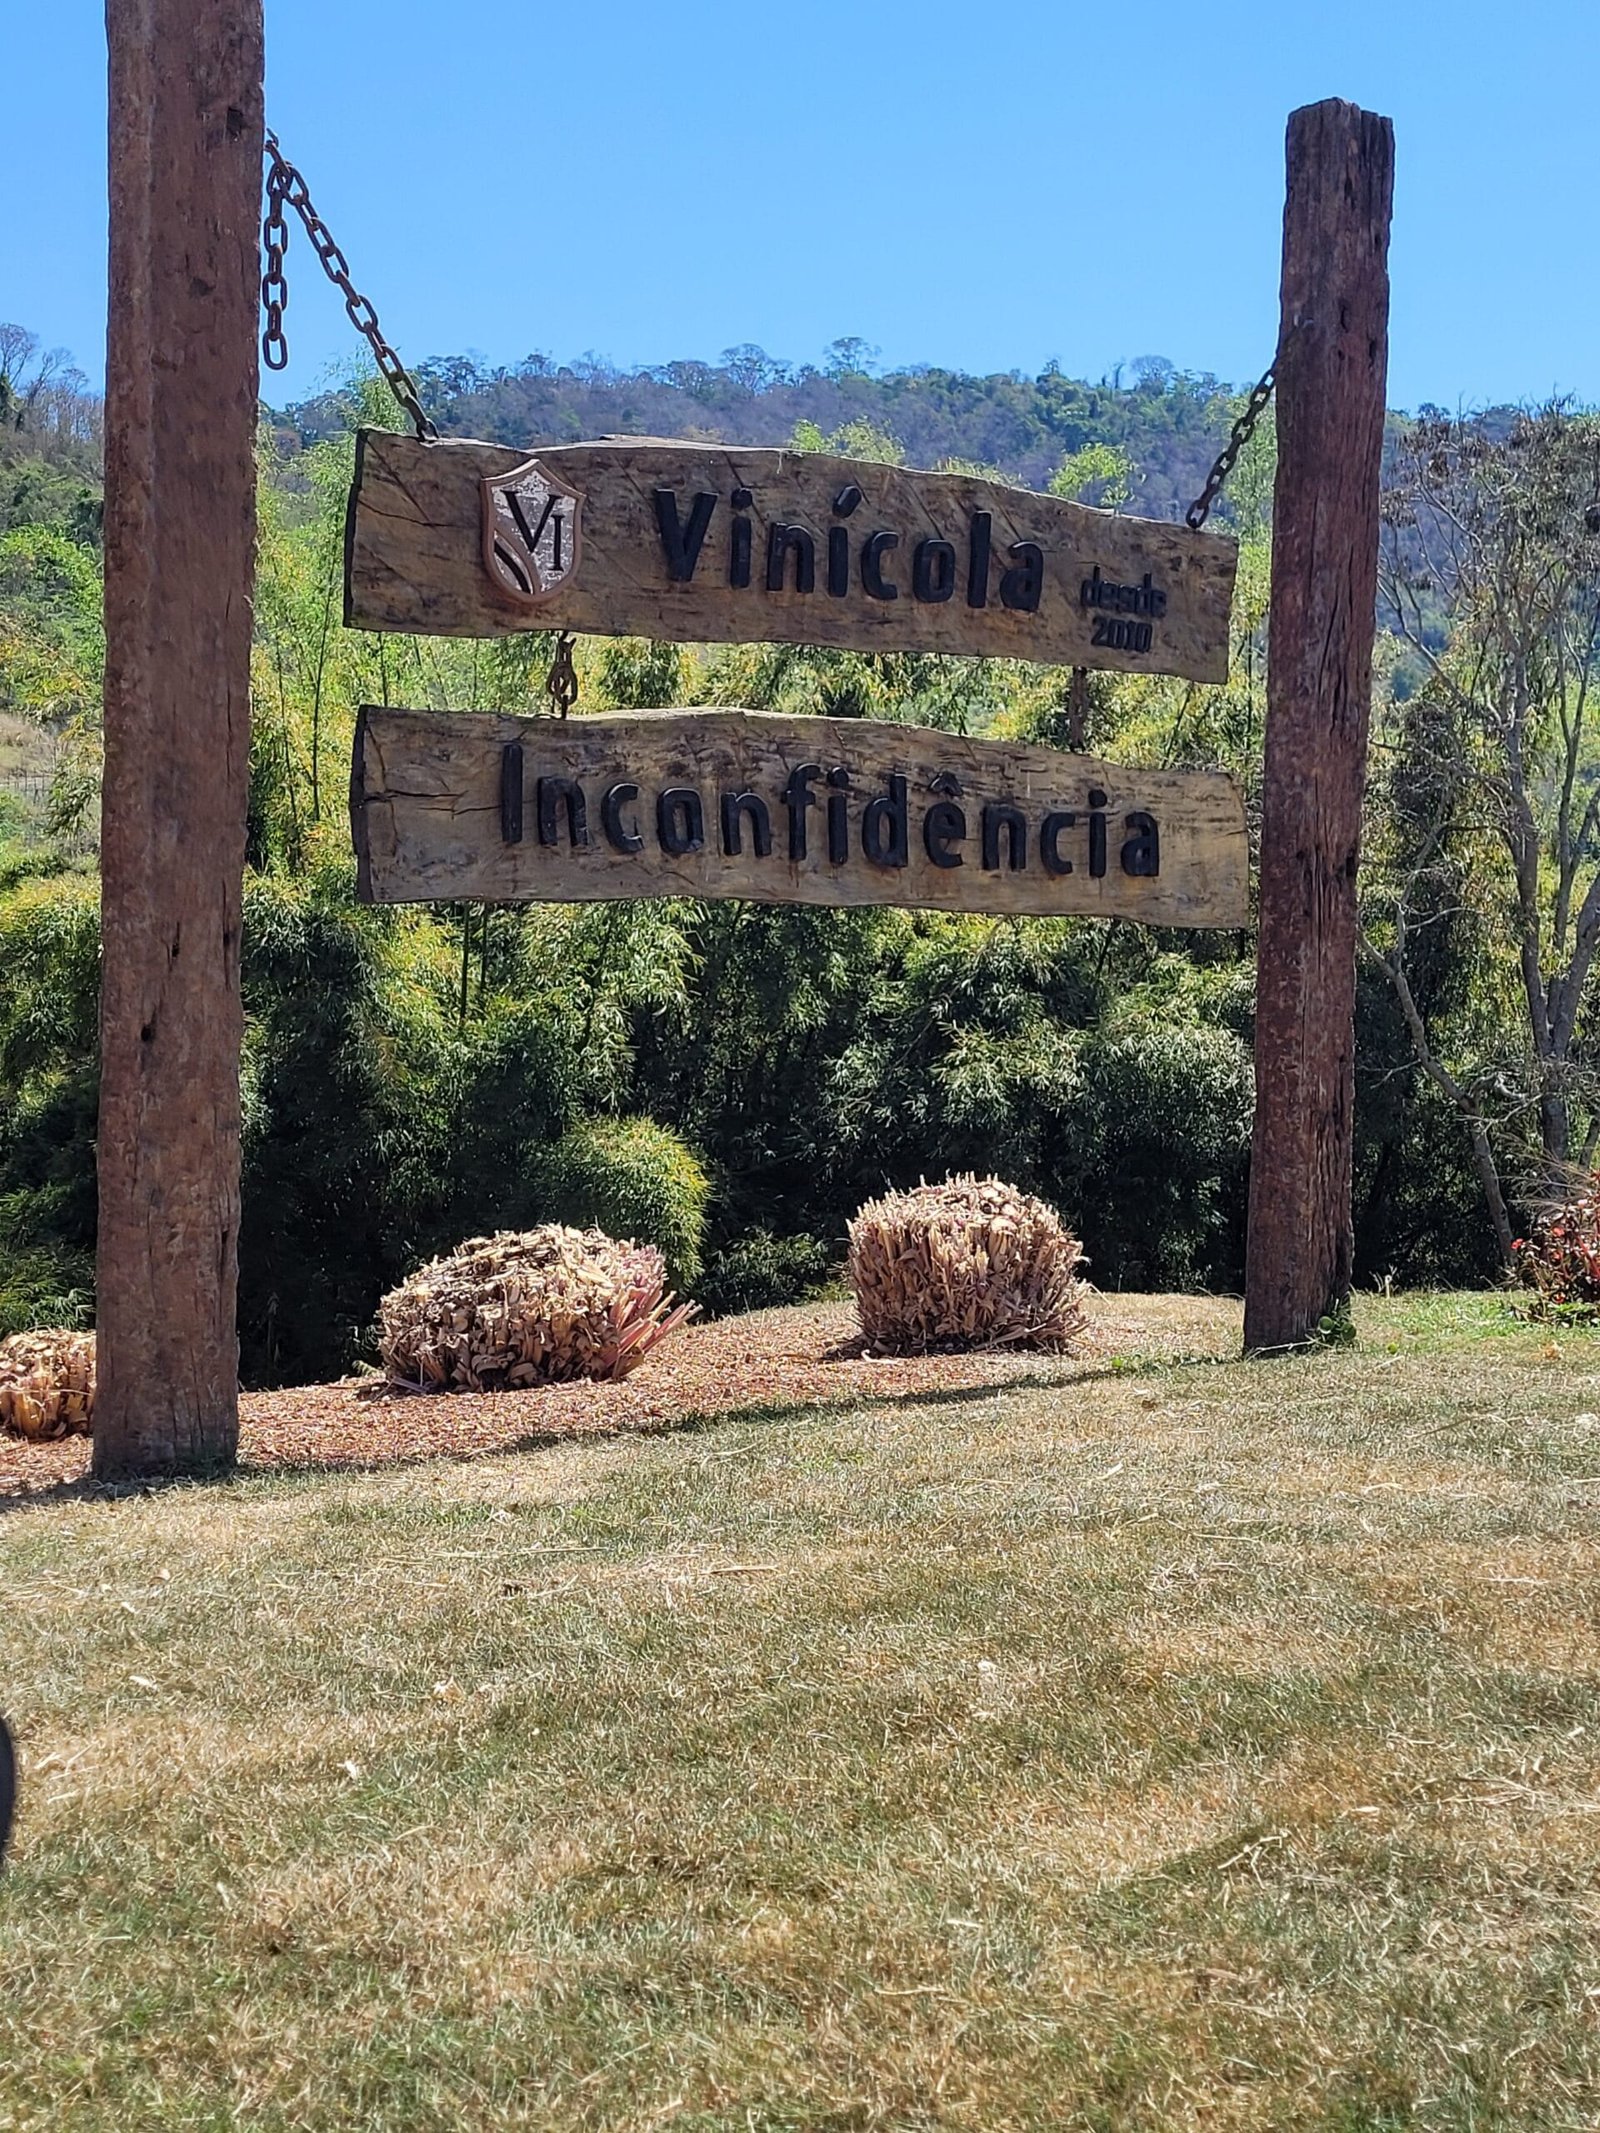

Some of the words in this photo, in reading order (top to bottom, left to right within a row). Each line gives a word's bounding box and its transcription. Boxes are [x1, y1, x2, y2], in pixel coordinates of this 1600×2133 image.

[500, 490, 565, 572] VI
[654, 485, 1044, 612] Vinícola
[1081, 565, 1168, 617] desde
[1091, 616, 1152, 654] 2010
[500, 742, 1161, 878] Inconfidência
